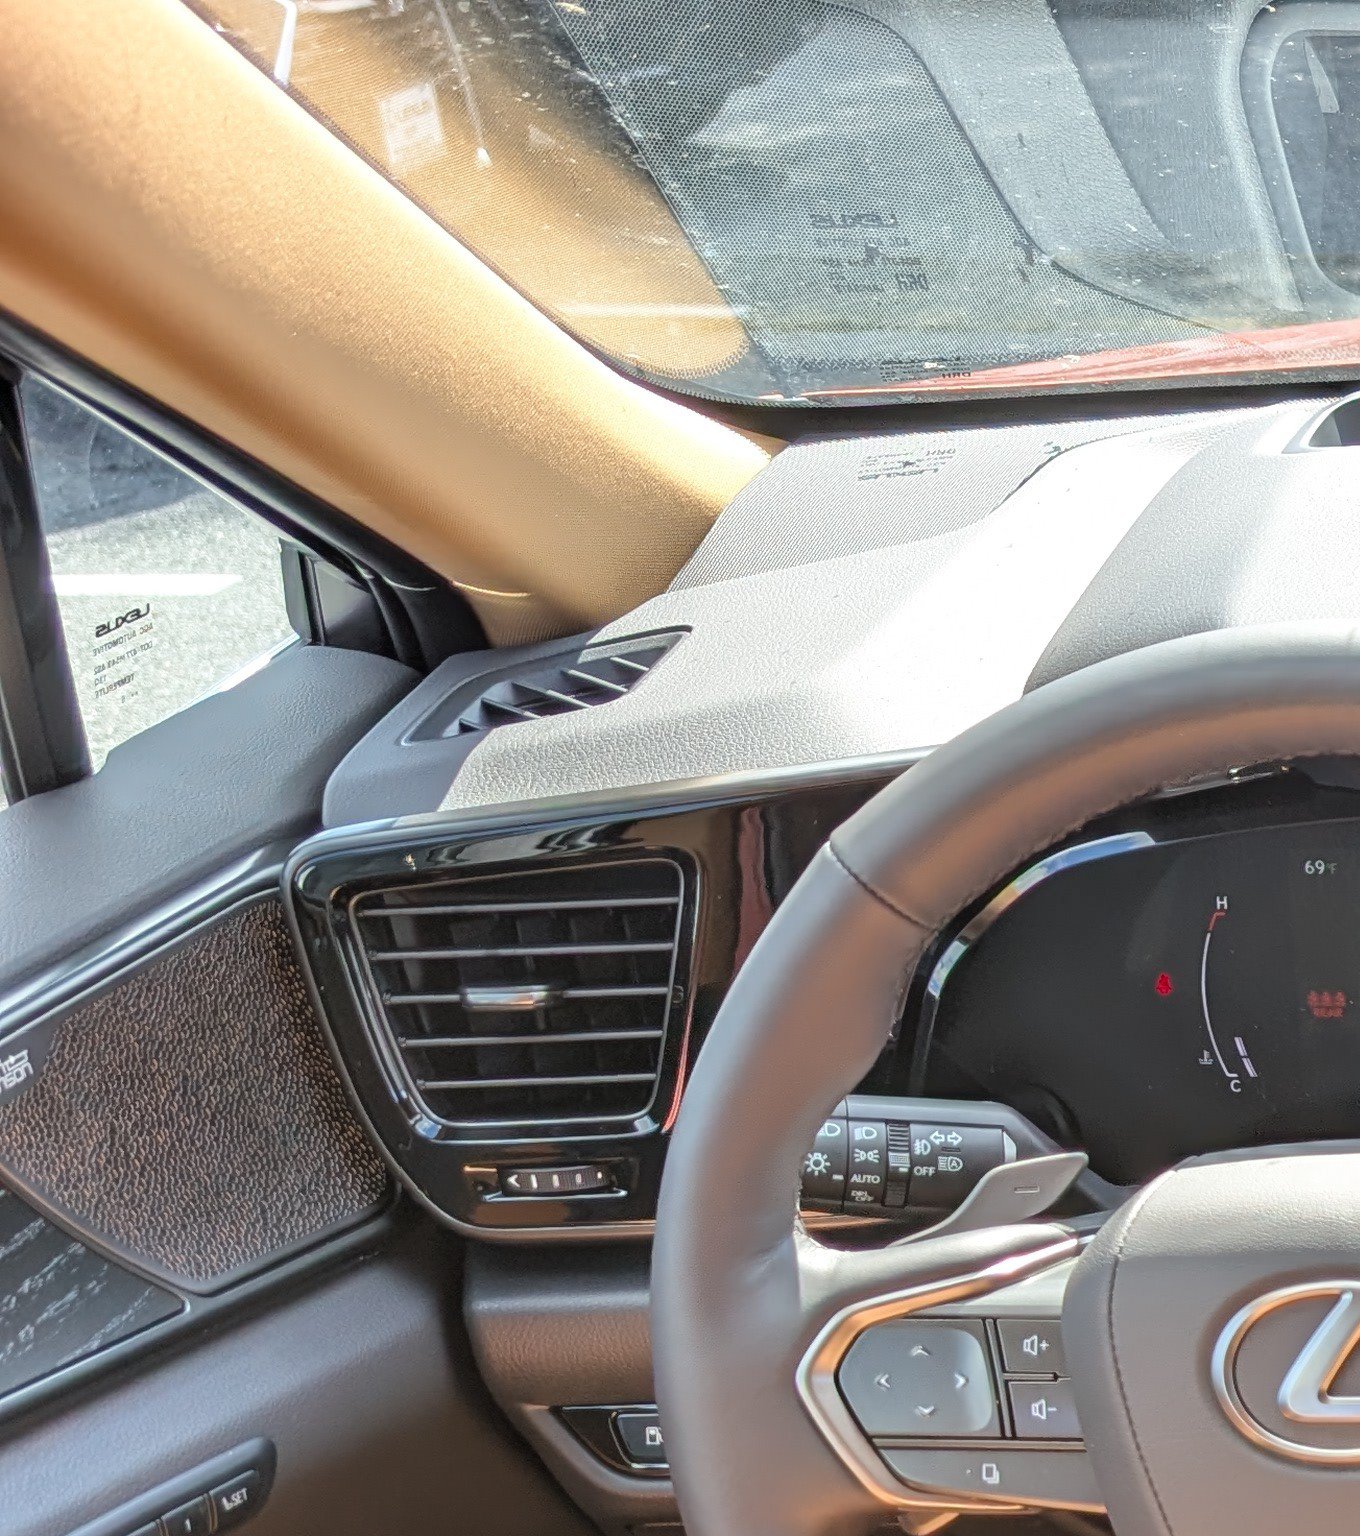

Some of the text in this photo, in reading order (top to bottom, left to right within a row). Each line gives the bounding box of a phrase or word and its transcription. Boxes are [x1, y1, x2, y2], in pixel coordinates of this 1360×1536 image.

[1216, 897, 1228, 910] H
[1230, 1080, 1241, 1093] C
[913, 1166, 936, 1176] OFF
[850, 1174, 881, 1184] AUTO
